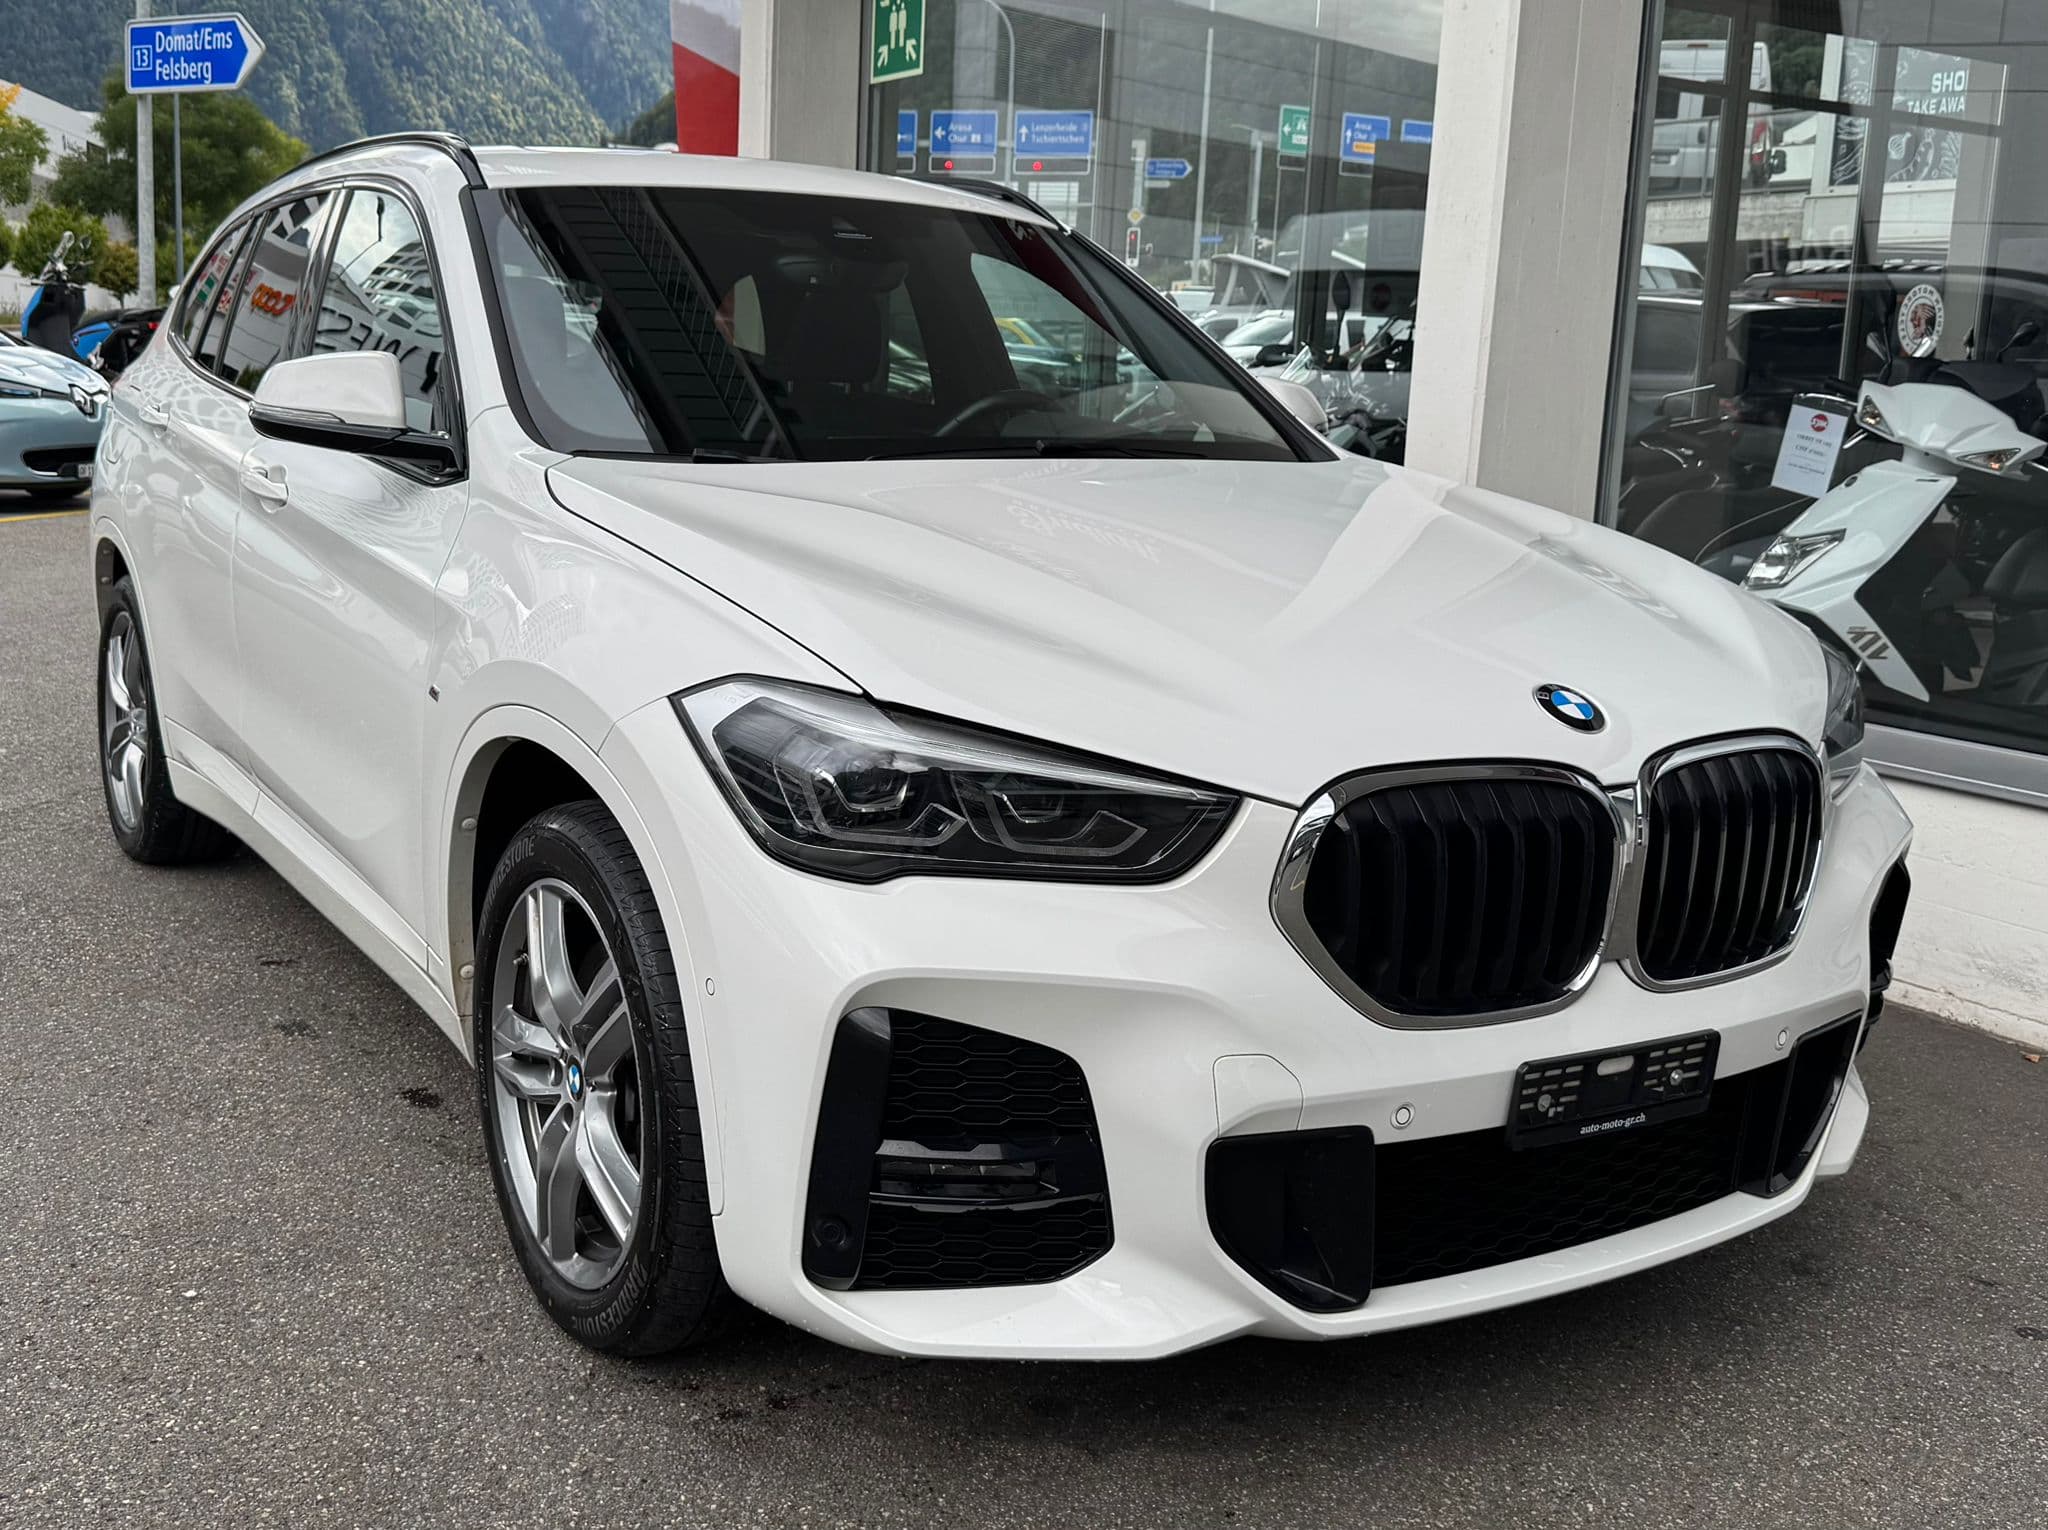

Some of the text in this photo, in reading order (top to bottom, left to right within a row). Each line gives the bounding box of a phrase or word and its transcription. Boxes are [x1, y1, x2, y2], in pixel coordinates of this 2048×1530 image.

[155, 27, 233, 53] Domat/Ems
[135, 49, 149, 67] 13
[155, 56, 212, 84] Felsberg
[1931, 69, 1969, 94] SHO
[1907, 95, 1965, 115] TAKE AWA
[1579, 1112, 1647, 1135] auto-moto-gr.ch
